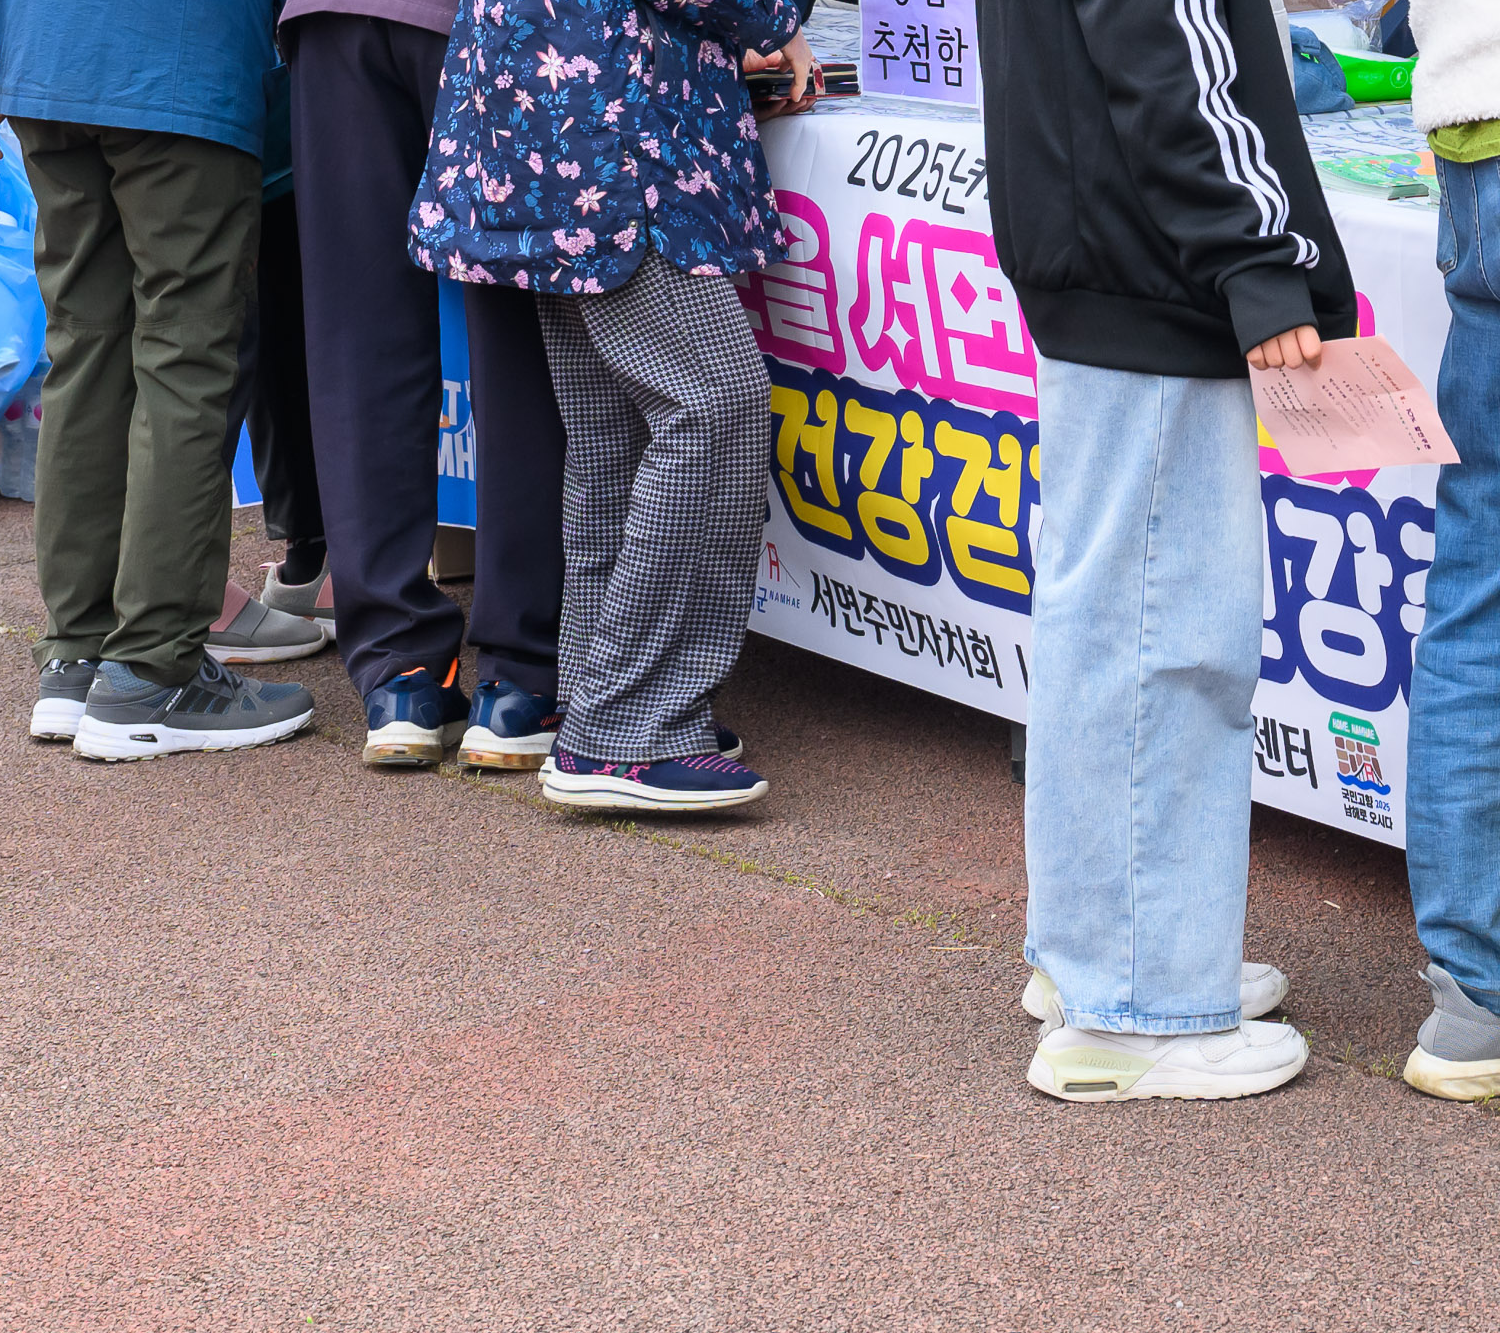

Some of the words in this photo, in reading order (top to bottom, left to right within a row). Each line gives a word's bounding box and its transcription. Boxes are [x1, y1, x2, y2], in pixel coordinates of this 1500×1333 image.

[867, 24, 969, 90] 추첨함
[768, 591, 801, 609] NAMHAE
[810, 569, 1002, 690] 서면주민자치회
[1341, 787, 1373, 808] 국민고향
[1375, 799, 1390, 812] 2025
[1344, 804, 1368, 822] 남해로
[1370, 811, 1393, 830] 오시다
